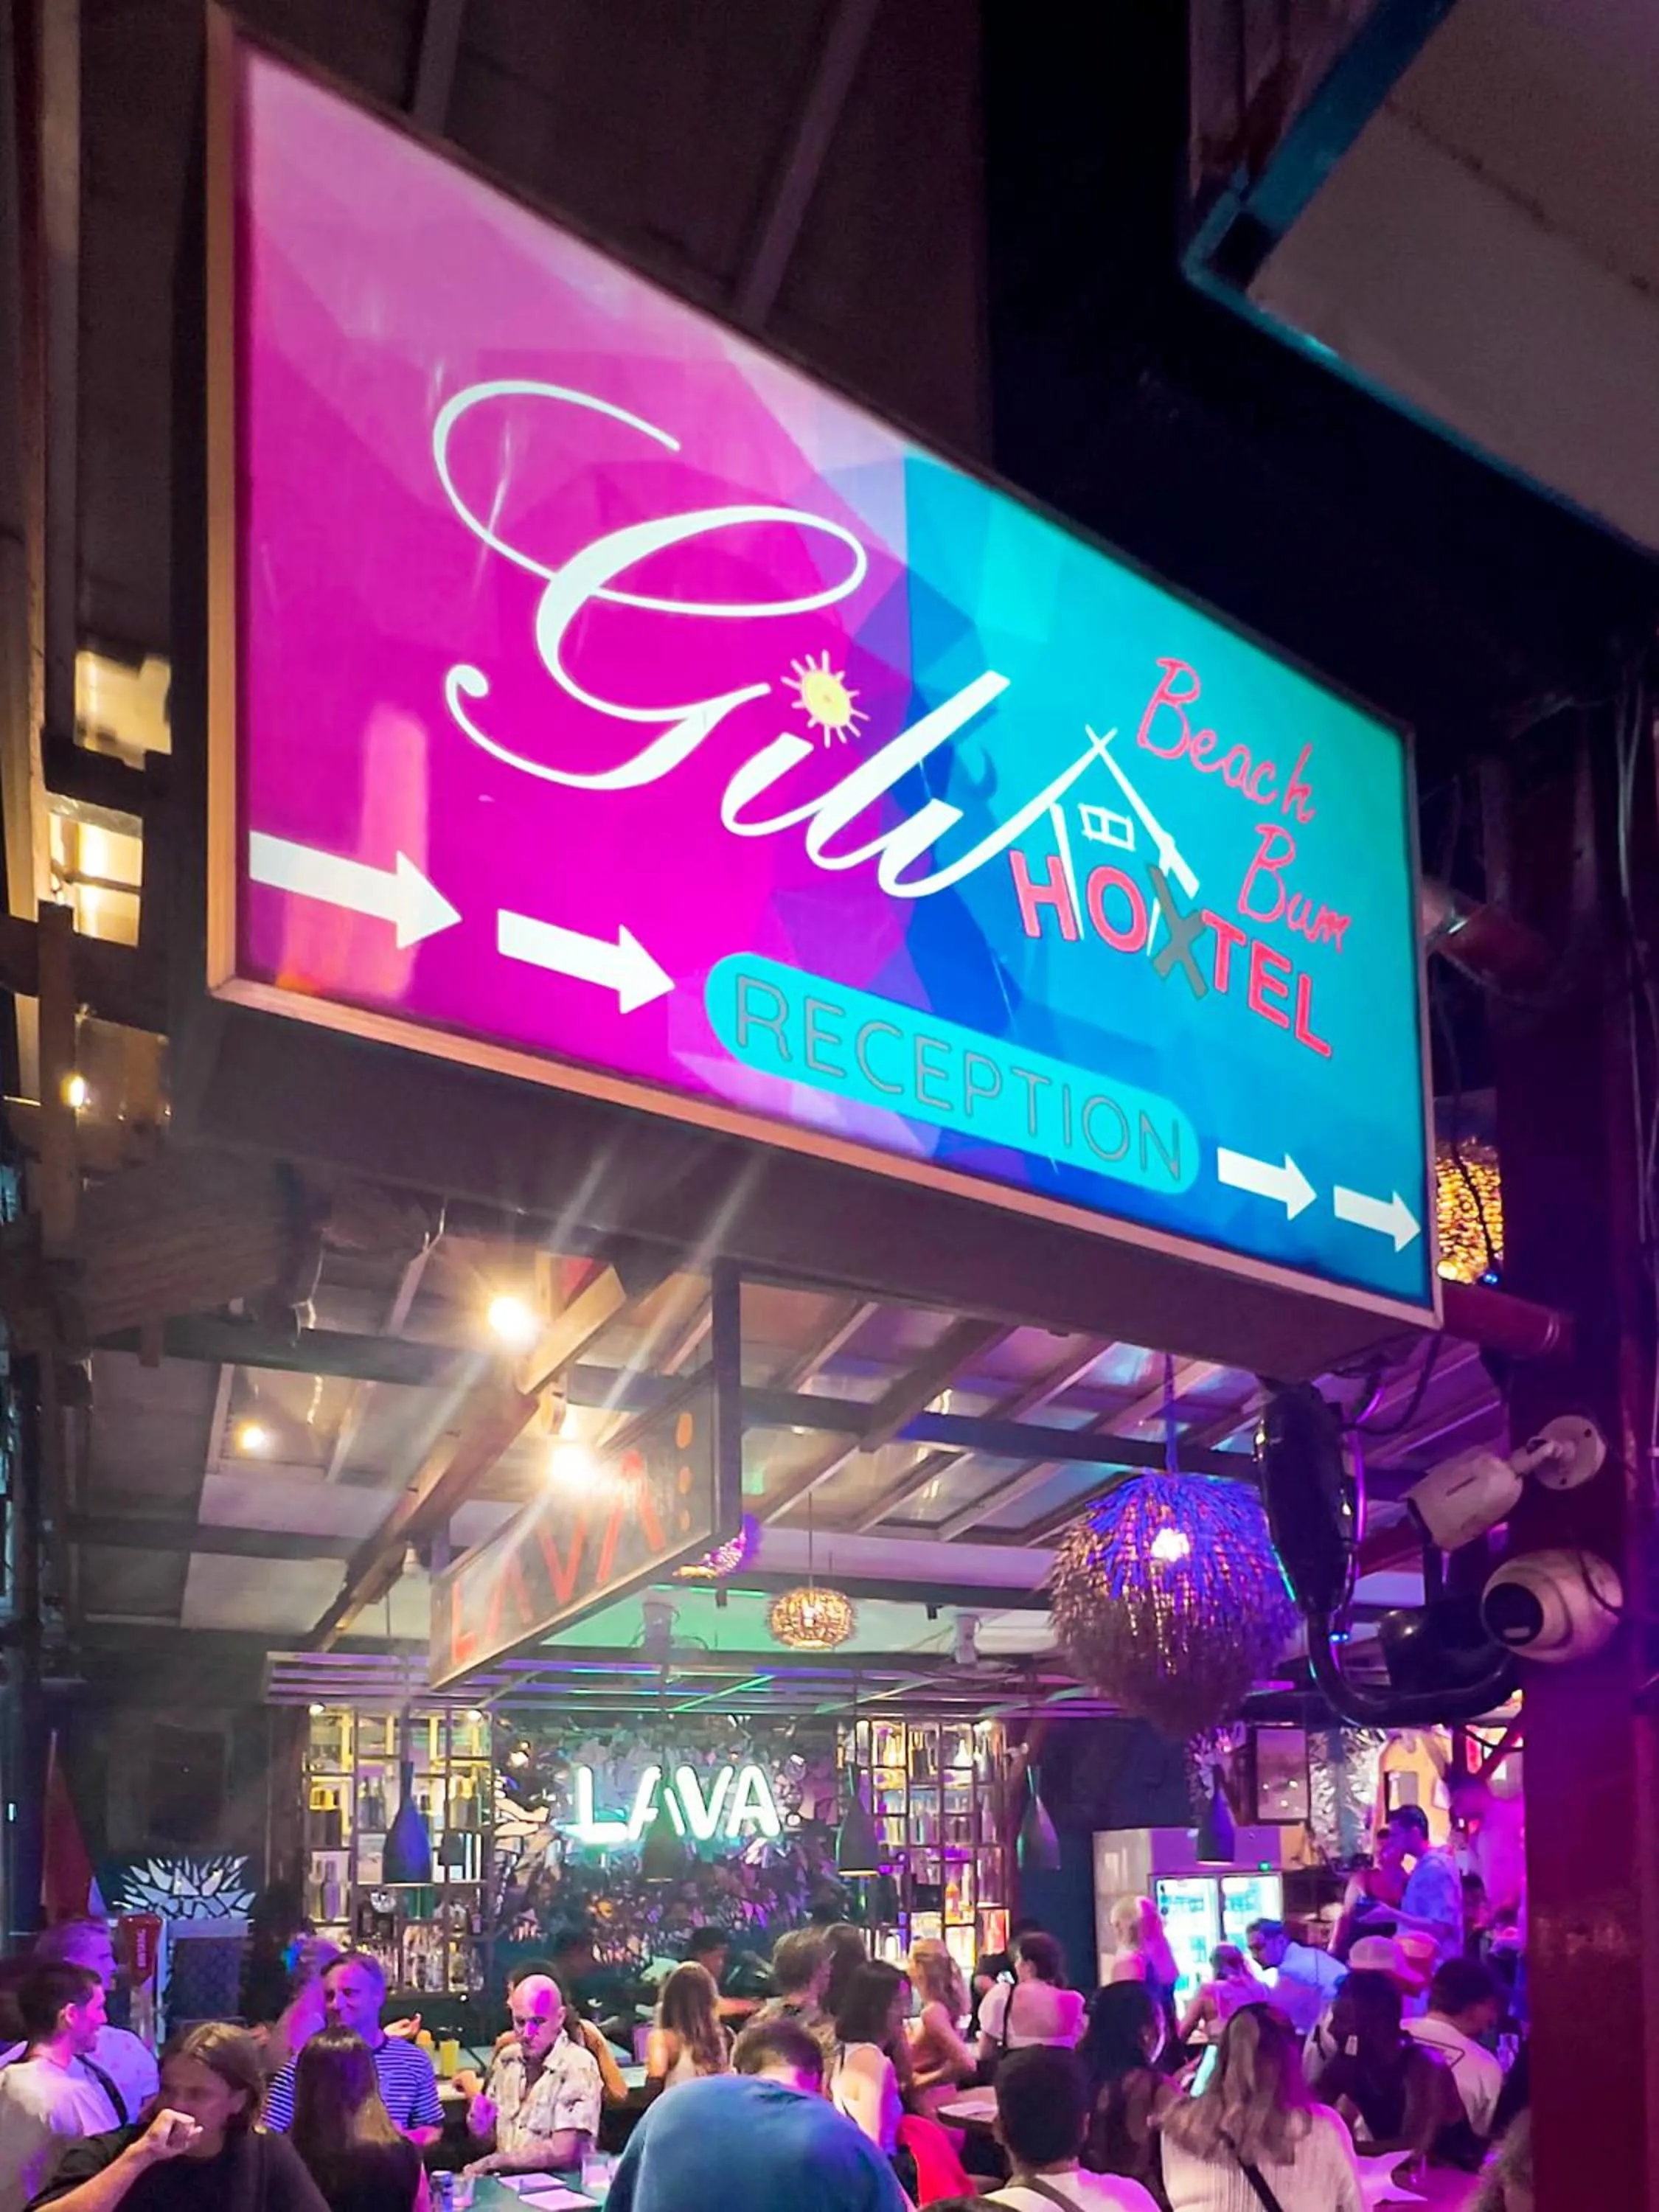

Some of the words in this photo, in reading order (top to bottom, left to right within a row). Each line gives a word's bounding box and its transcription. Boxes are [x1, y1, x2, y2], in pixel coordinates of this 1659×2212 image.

[1136, 657, 1315, 824] Beach
[1238, 824, 1352, 954] Bum
[737, 973, 1180, 1182] RECEPTION
[451, 1450, 667, 1666] LAVA
[574, 1764, 782, 1843] LAVA
